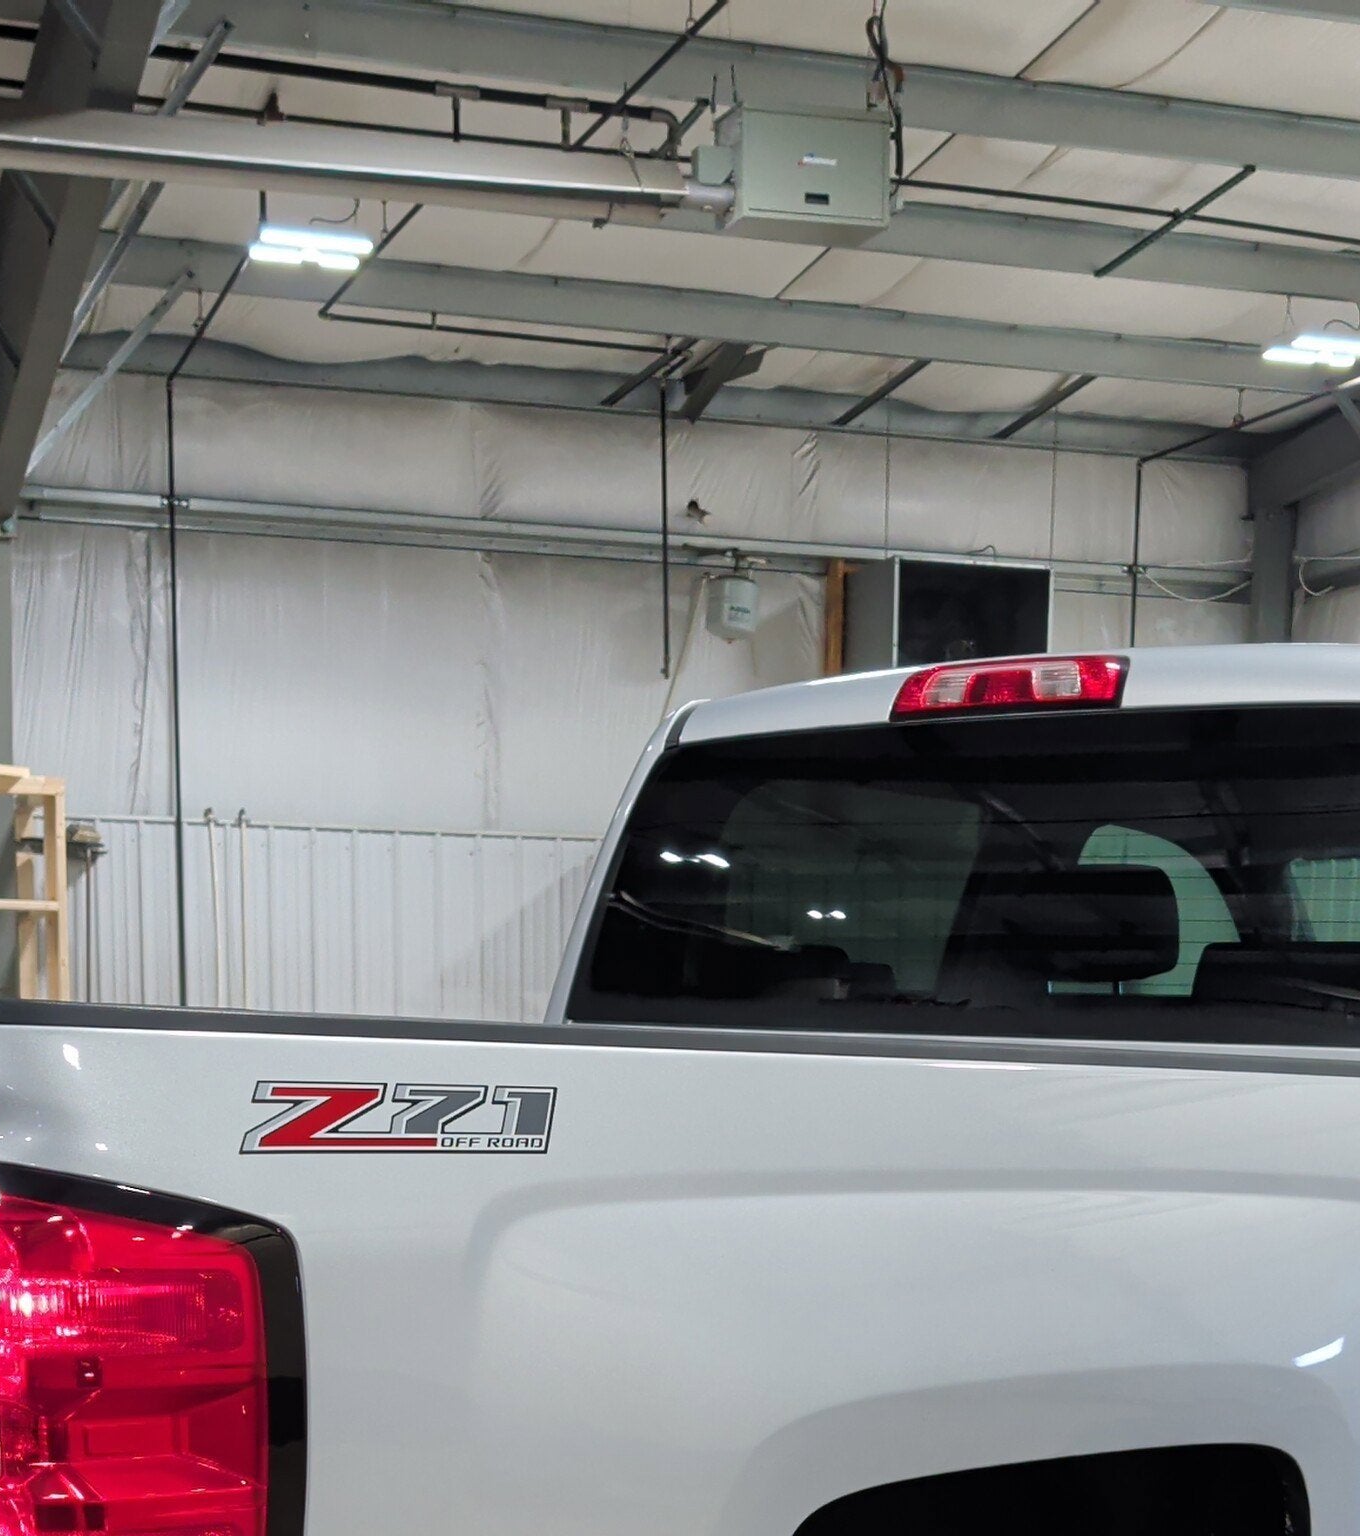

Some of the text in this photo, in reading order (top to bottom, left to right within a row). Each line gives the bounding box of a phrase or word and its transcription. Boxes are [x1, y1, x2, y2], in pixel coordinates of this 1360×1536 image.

[239, 1080, 558, 1155] Z71
[440, 1136, 544, 1149] OFF ROAD
